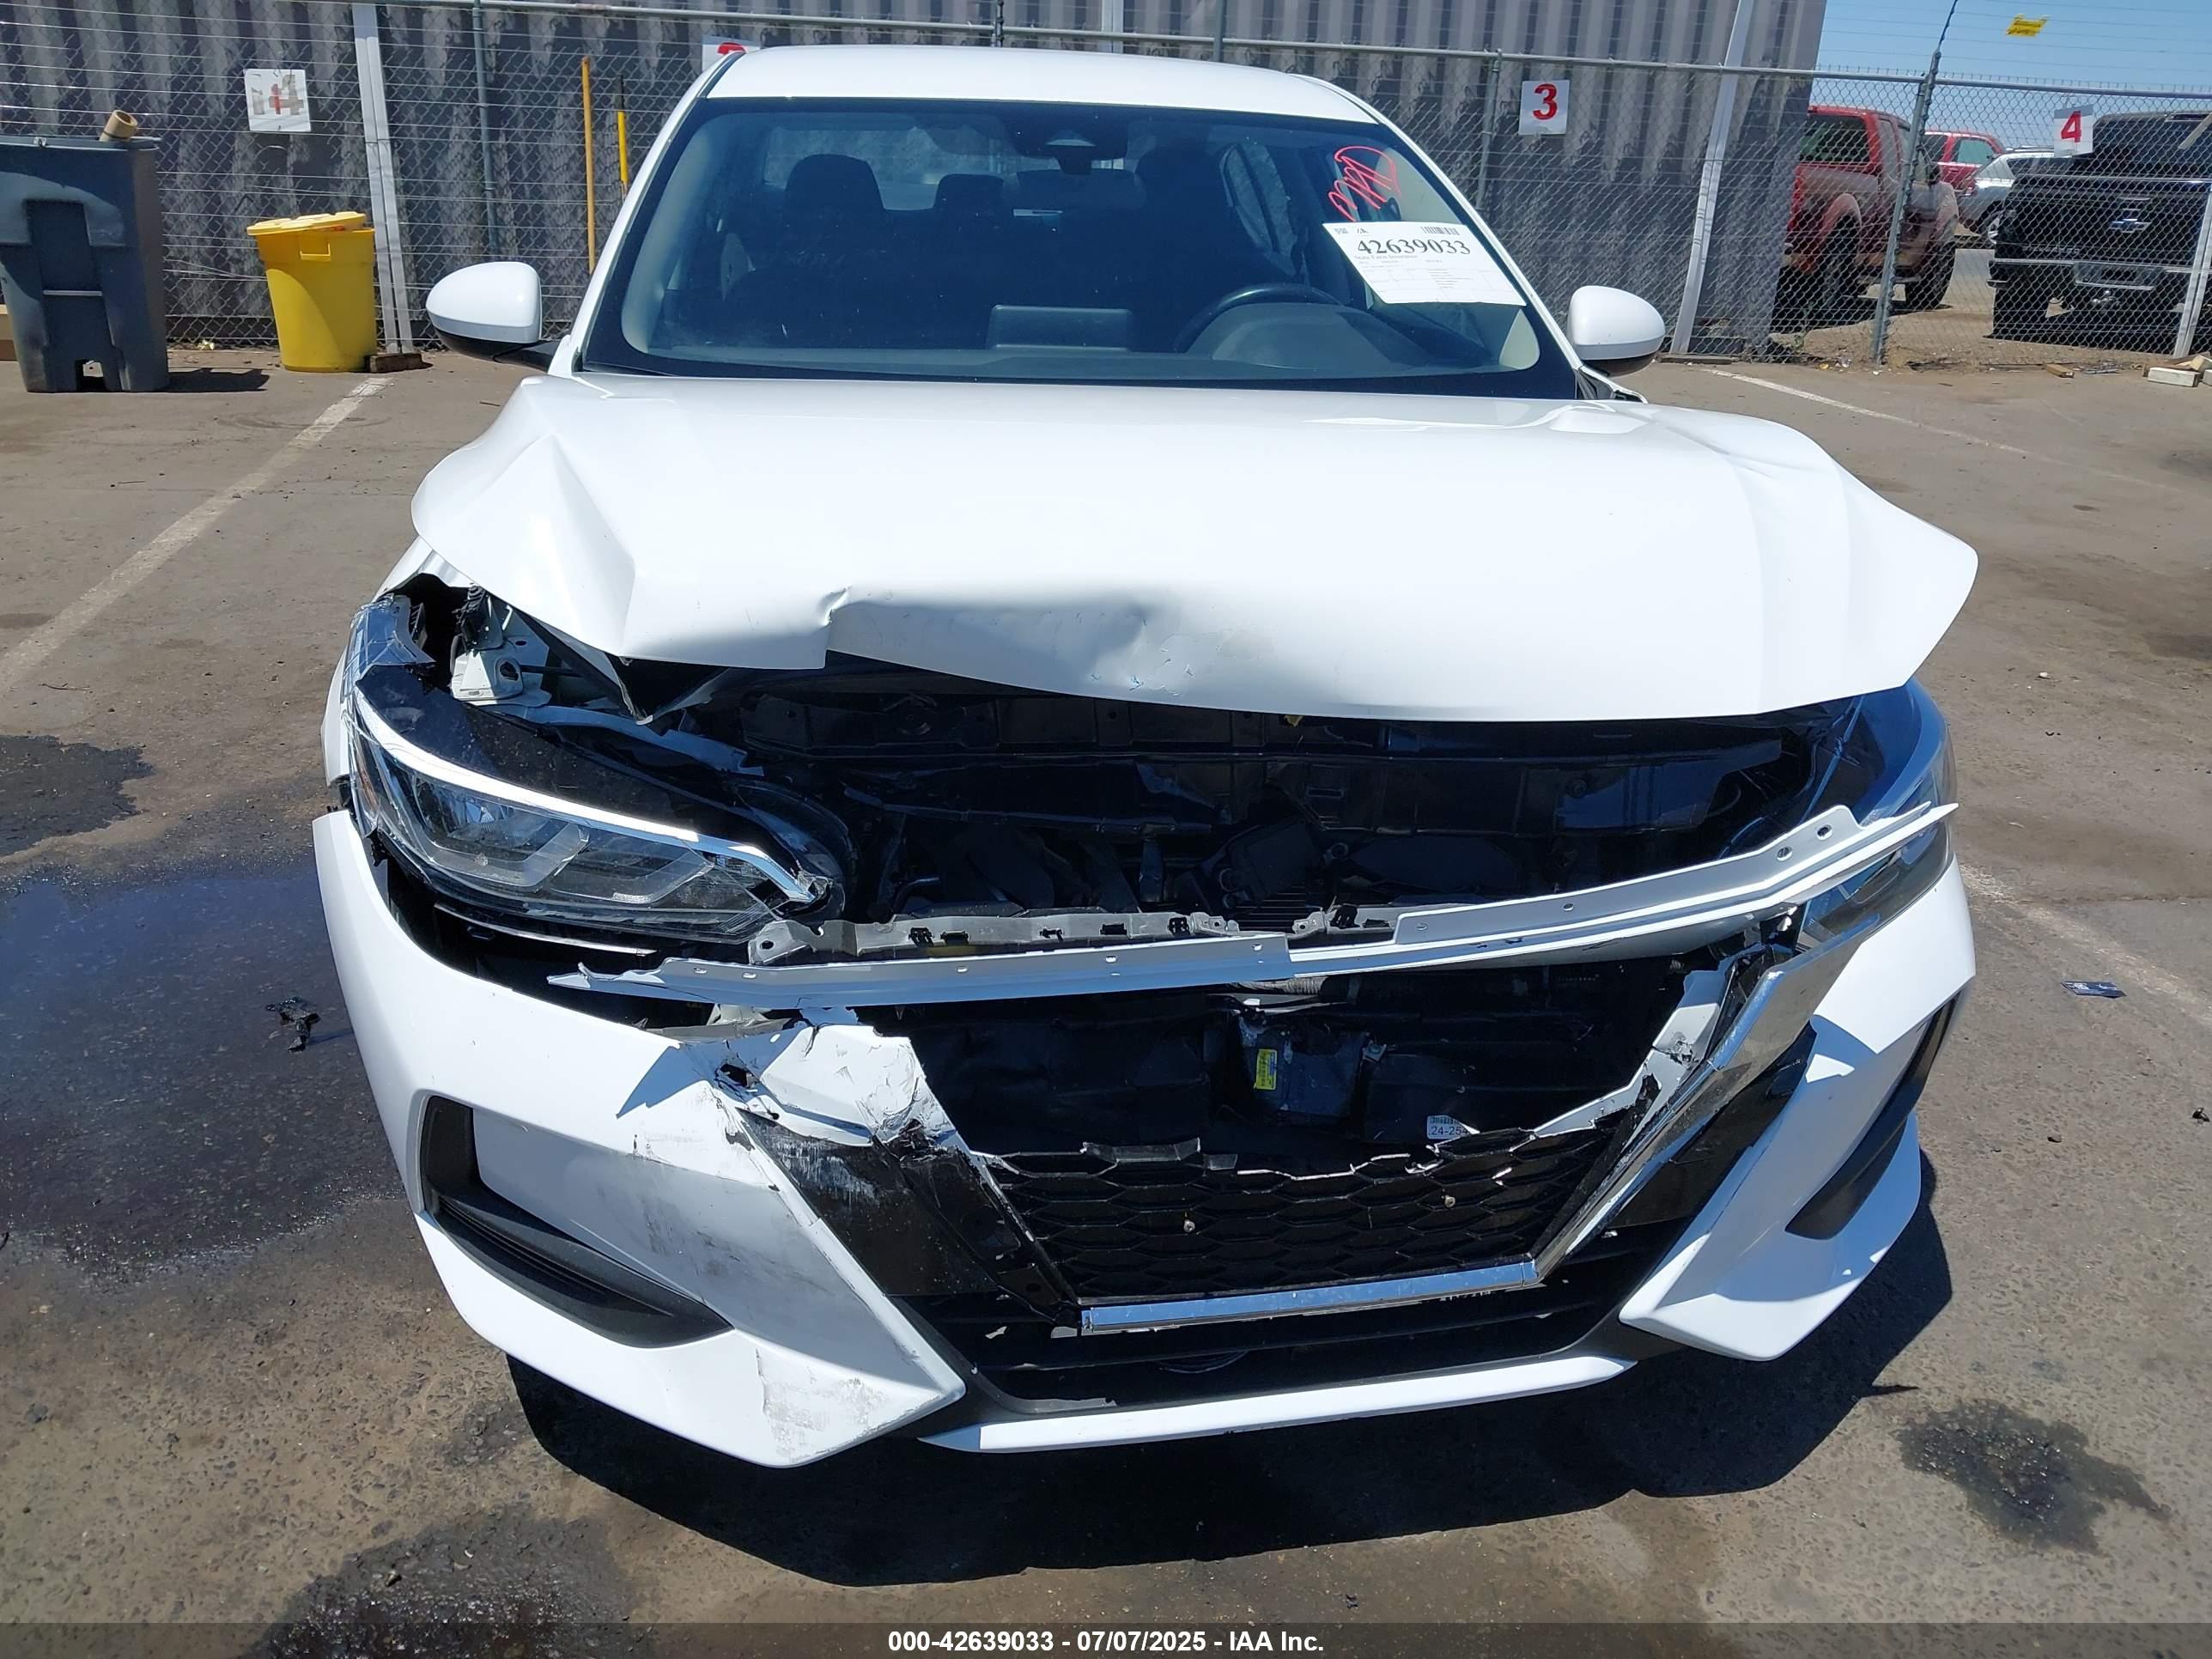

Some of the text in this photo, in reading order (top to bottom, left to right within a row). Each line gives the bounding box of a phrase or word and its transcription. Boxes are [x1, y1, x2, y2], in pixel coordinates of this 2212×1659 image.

[1533, 83, 1558, 120] 3
[2061, 111, 2081, 143] 4
[1358, 239, 1471, 255] 42639033
